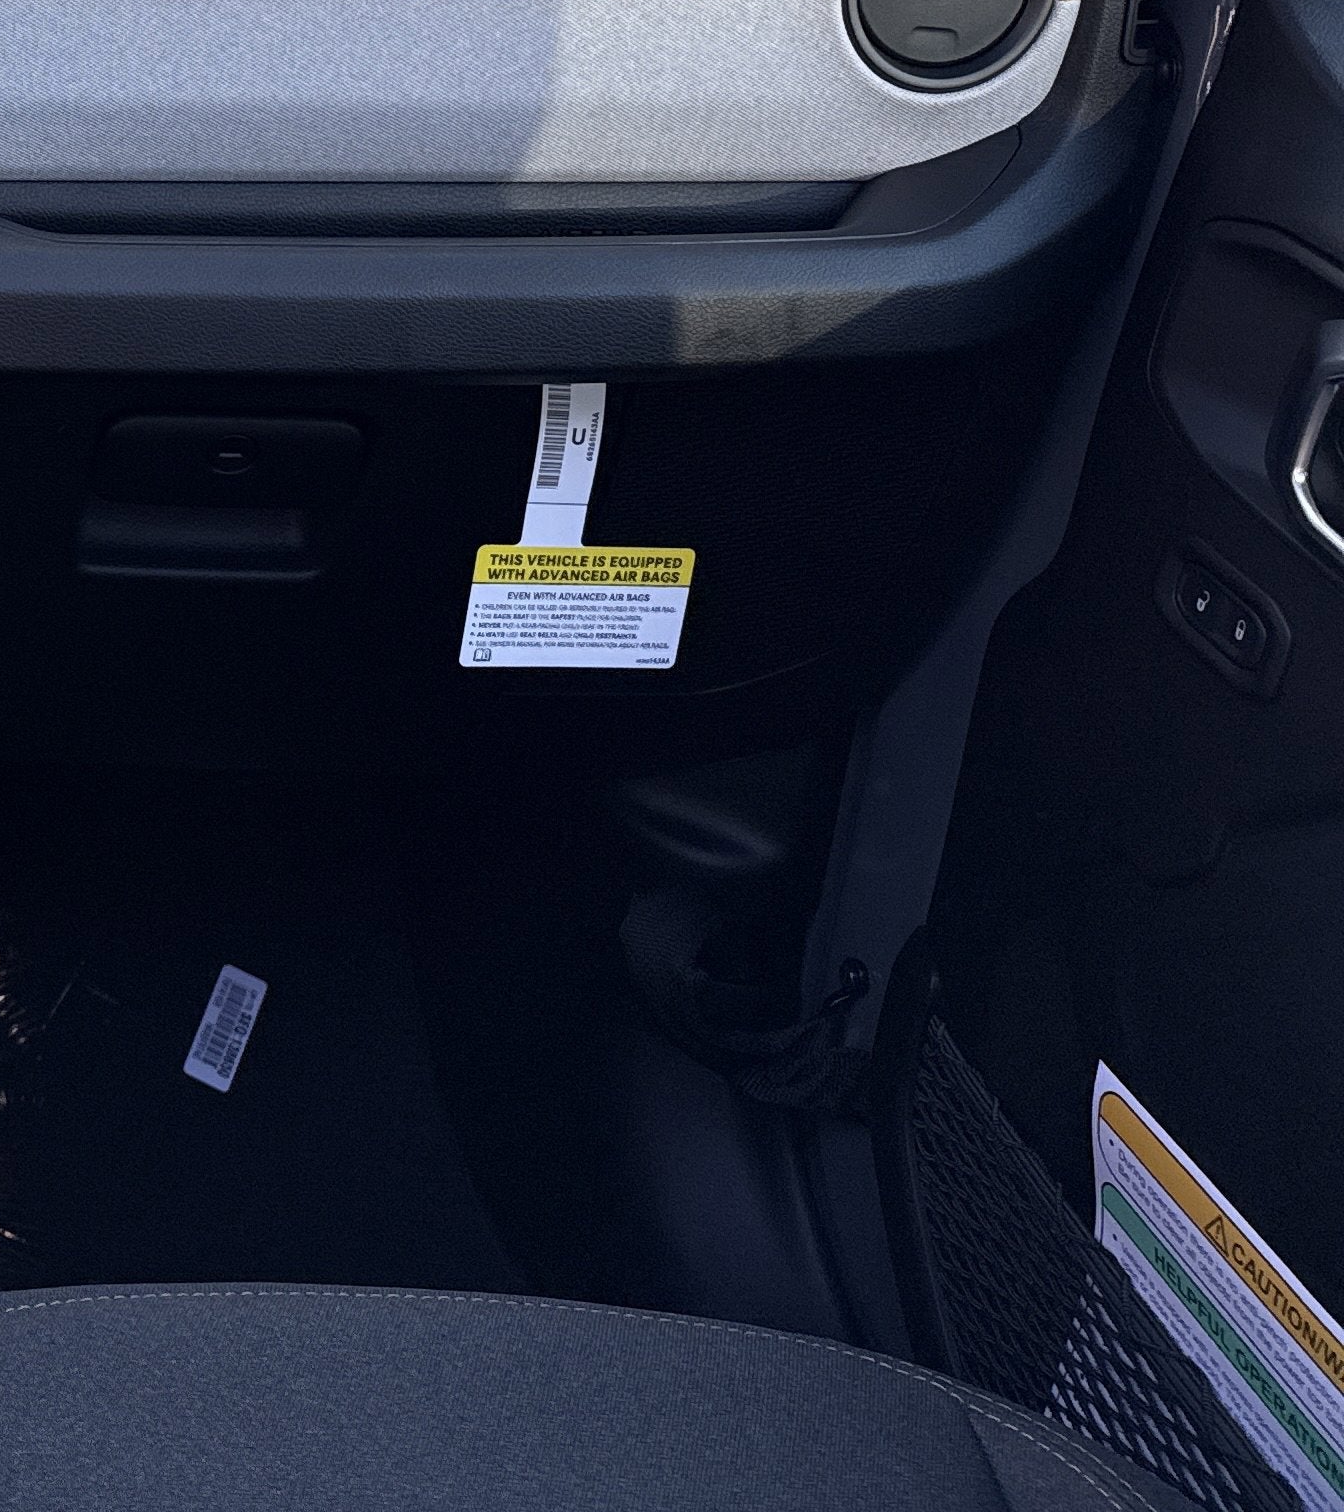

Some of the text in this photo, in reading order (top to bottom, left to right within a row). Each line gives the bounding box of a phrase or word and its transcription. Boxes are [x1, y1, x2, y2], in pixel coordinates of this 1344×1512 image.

[490, 553, 683, 569] THIS VEHICLE IS EQUIPPED
[488, 568, 680, 584] WITH ADVANCED AIR BAGS
[507, 591, 651, 602] EVEN WITH ADVANCED AIR BAGS
[1154, 1246, 1229, 1351] HELPFUL
